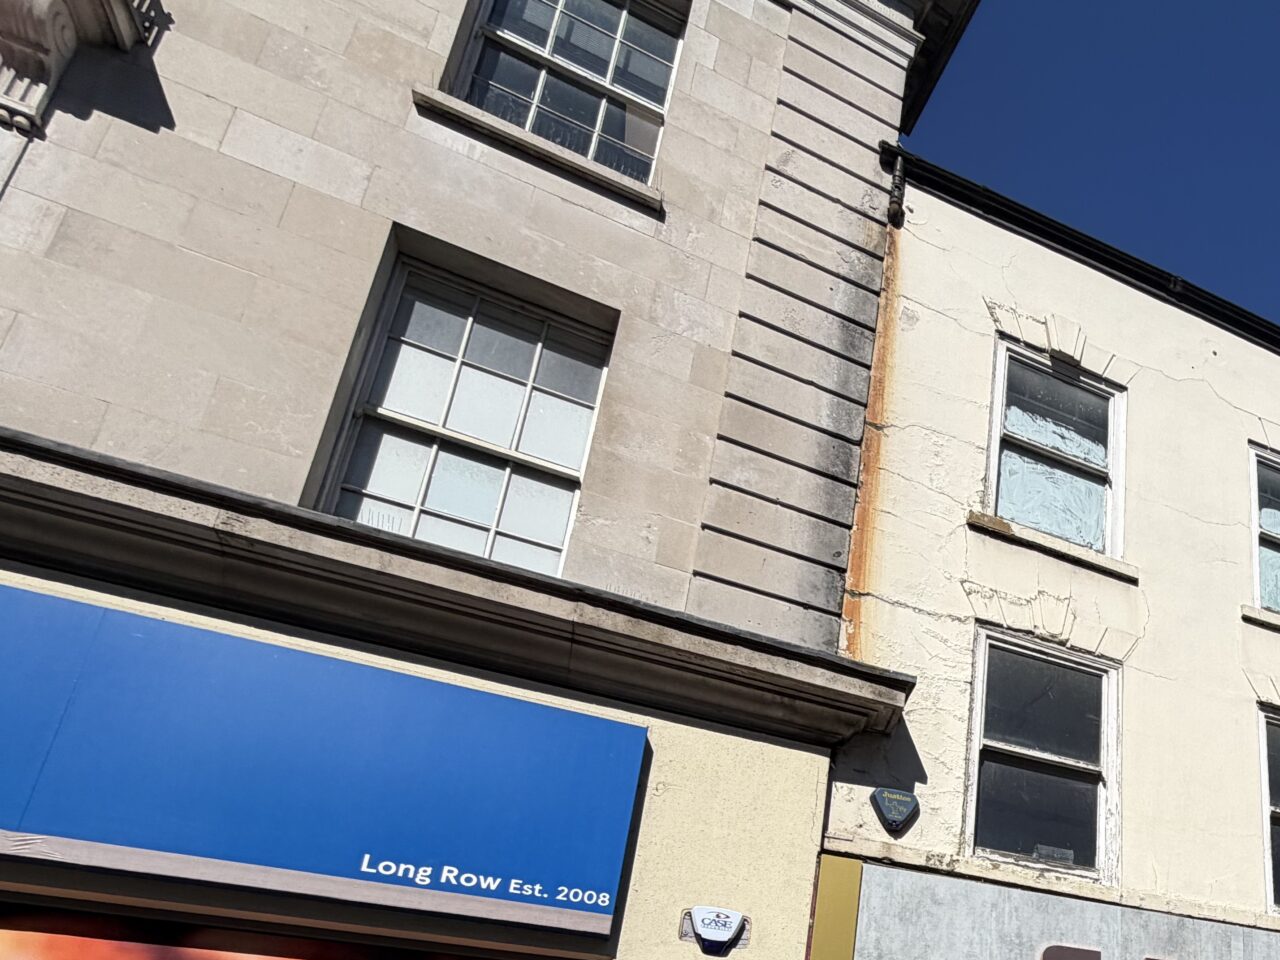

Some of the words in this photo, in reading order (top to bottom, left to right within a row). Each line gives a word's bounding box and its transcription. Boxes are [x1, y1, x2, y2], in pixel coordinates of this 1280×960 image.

[360, 853, 432, 885] Long
[440, 865, 502, 891] Row
[508, 879, 549, 898] Est.
[555, 886, 611, 907] 2008
[701, 917, 733, 929] CASE
